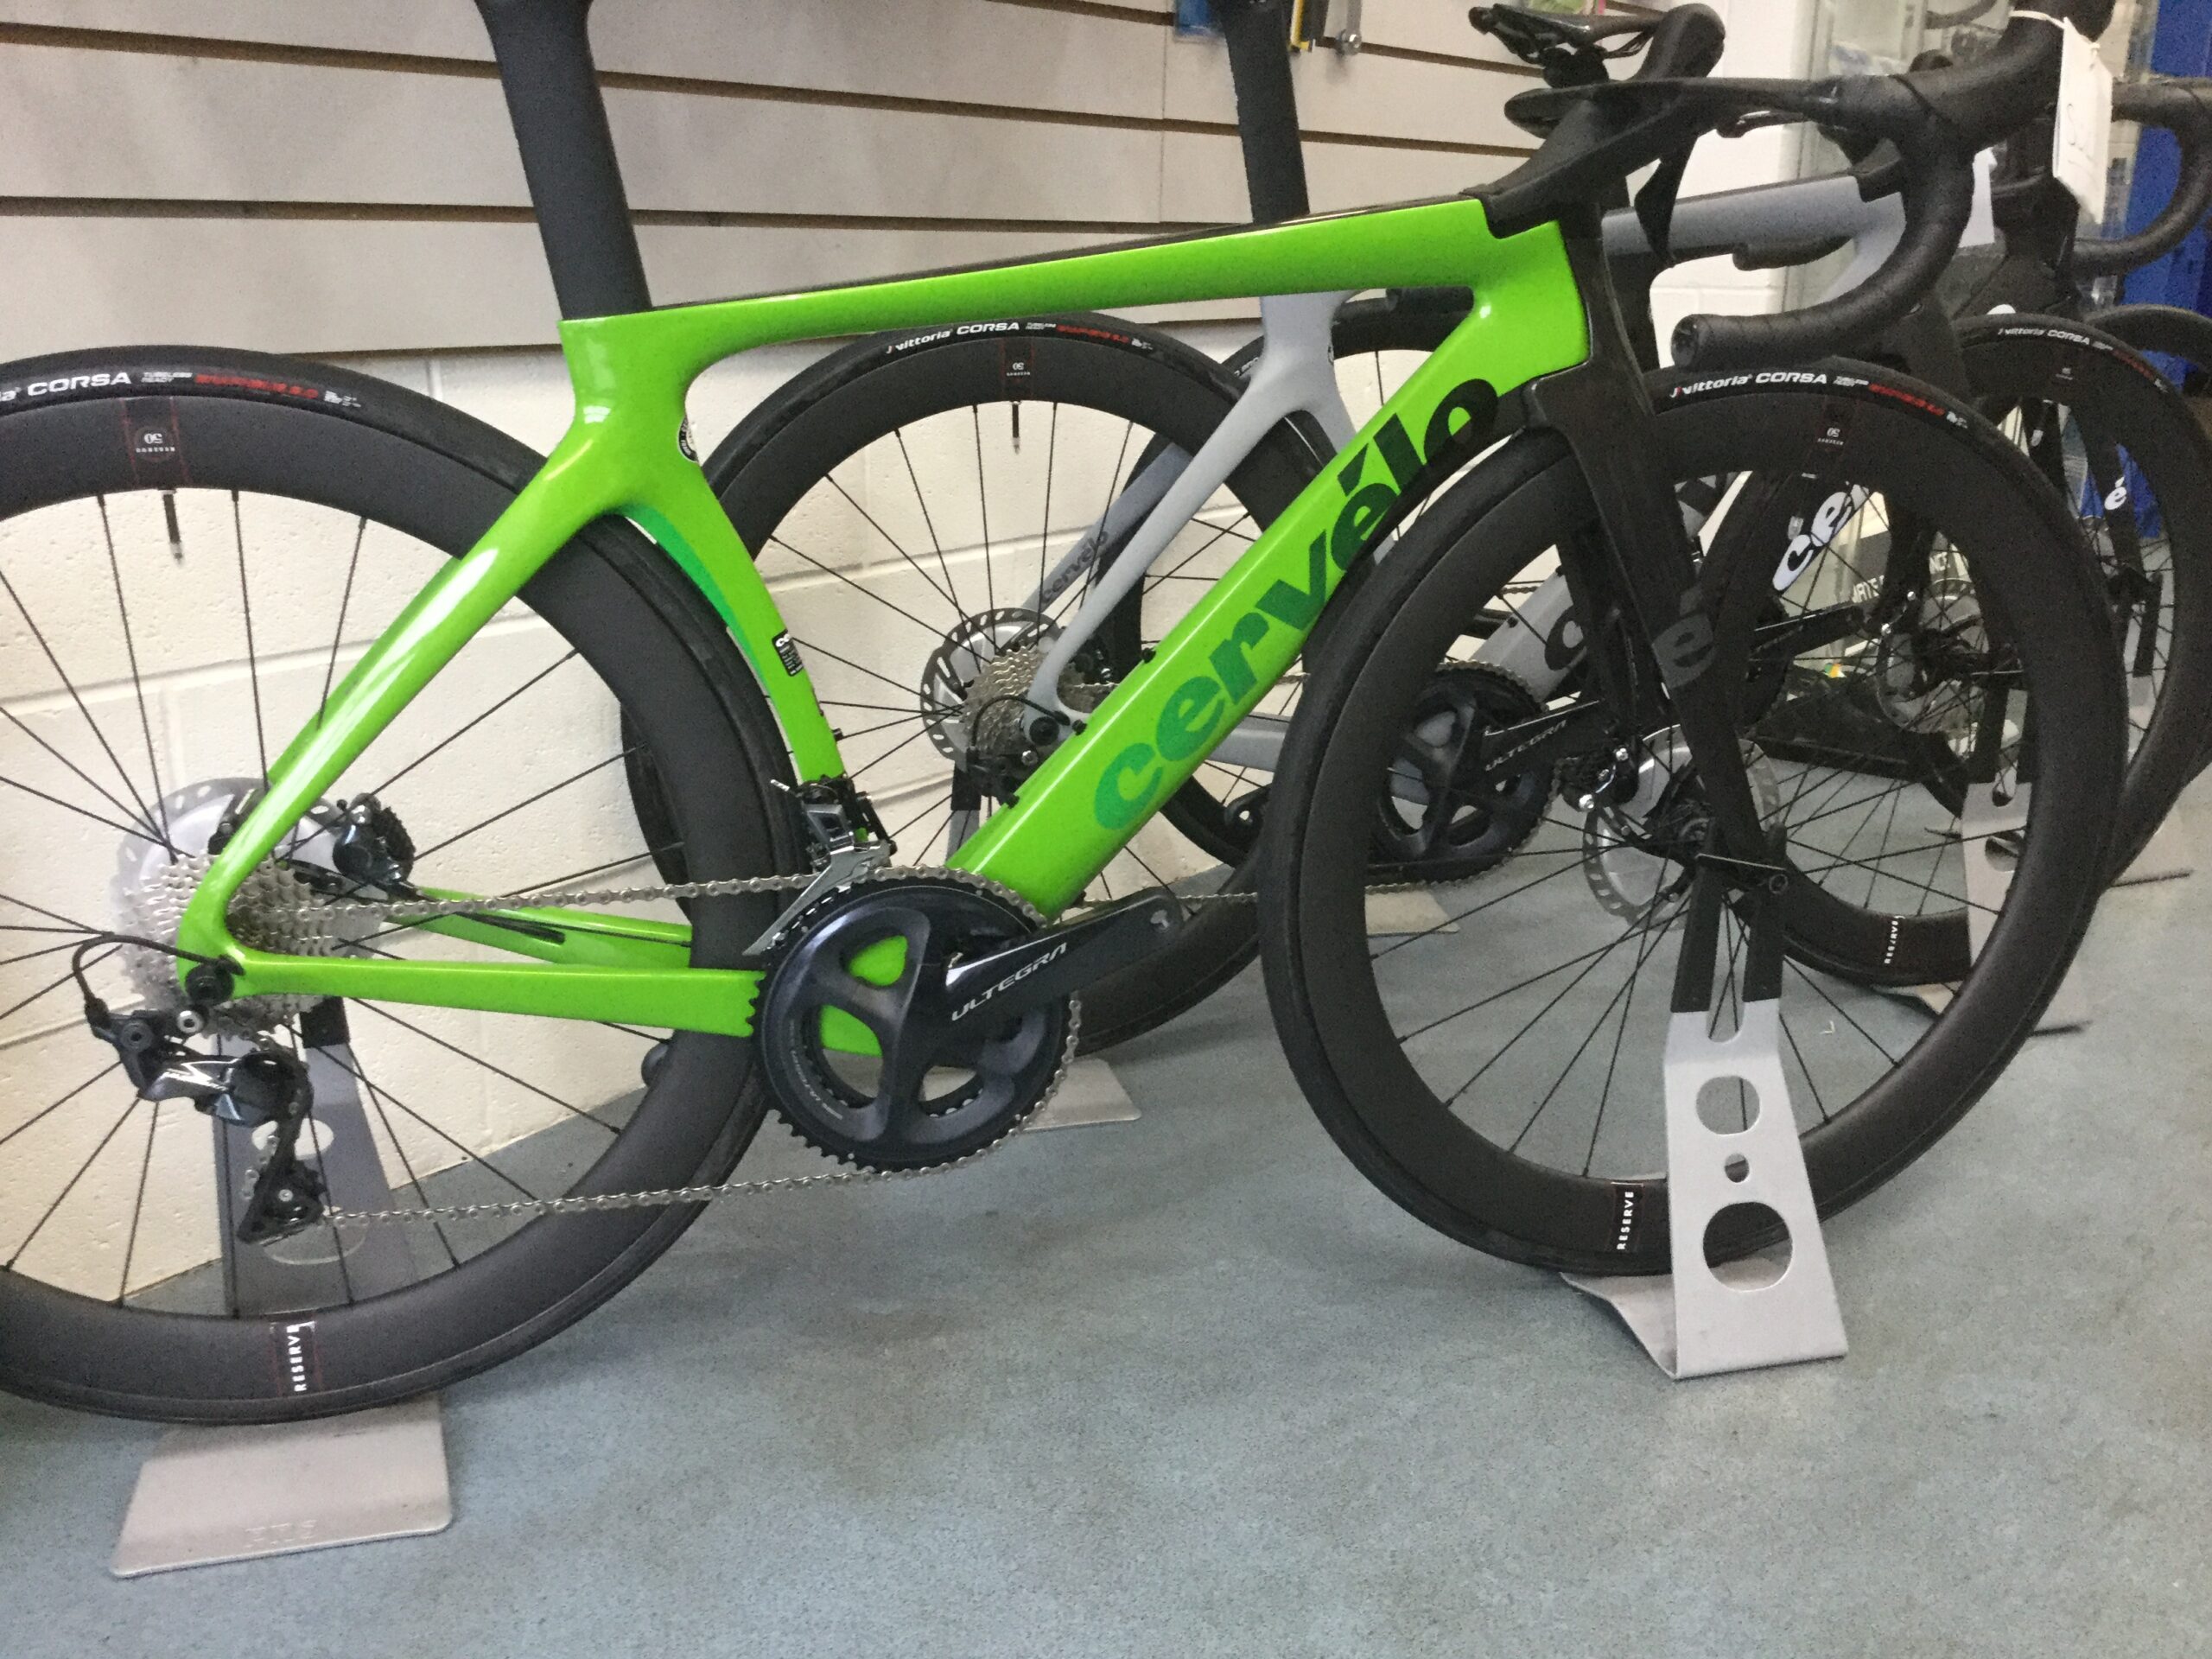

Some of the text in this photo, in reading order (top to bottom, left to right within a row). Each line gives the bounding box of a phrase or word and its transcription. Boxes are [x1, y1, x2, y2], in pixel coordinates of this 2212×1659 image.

[895, 329, 951, 352] vittoria
[957, 321, 1020, 335] CORSA
[2047, 329, 2090, 345] CORSA
[28, 372, 132, 397] CORSA
[1681, 375, 1749, 395] vittoria
[1755, 372, 1827, 385] CORSA
[952, 942, 1067, 1021] ULTEGRA
[1617, 1192, 1635, 1250] RESERVE
[286, 1324, 308, 1392] RESERVE
